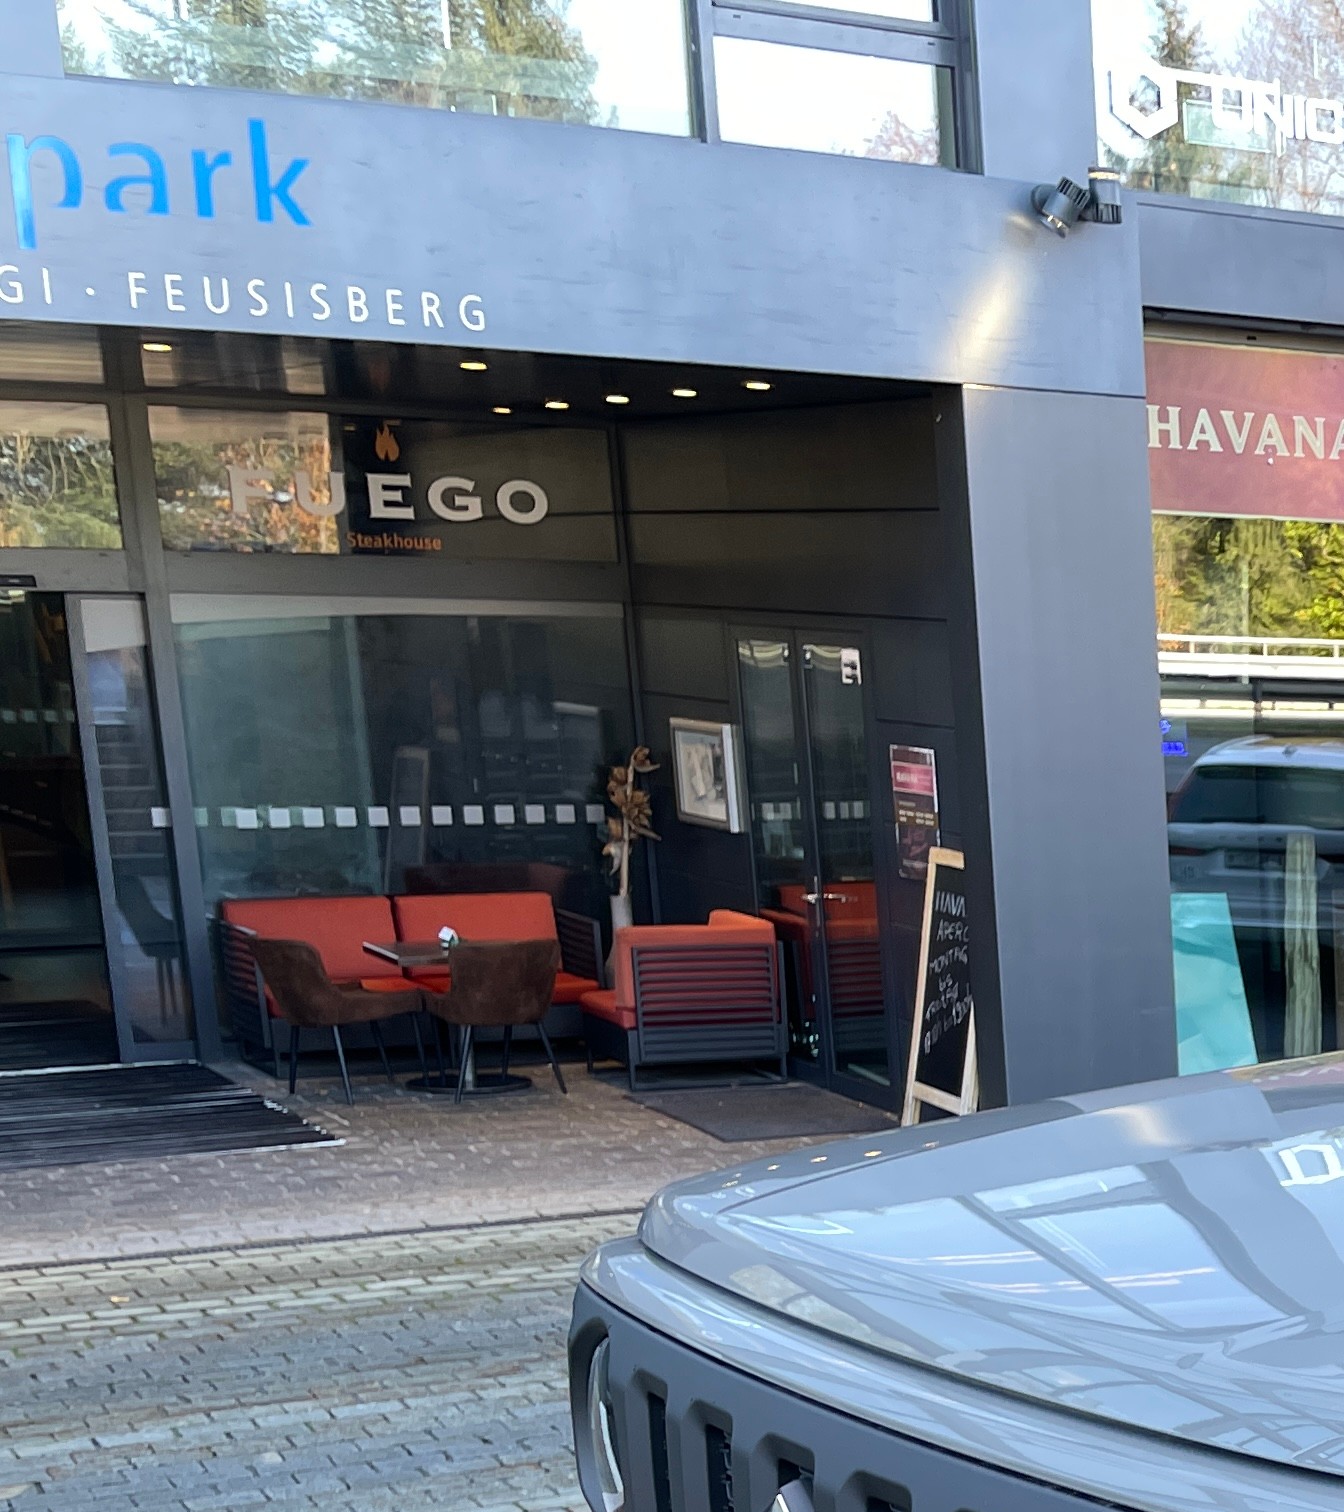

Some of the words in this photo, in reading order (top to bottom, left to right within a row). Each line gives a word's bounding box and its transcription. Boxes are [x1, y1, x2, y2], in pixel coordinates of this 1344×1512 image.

[7, 117, 313, 250] park
[127, 270, 487, 331] FEUSISBERG
[226, 464, 549, 525] FUEGO
[347, 532, 442, 551] Steakhouse
